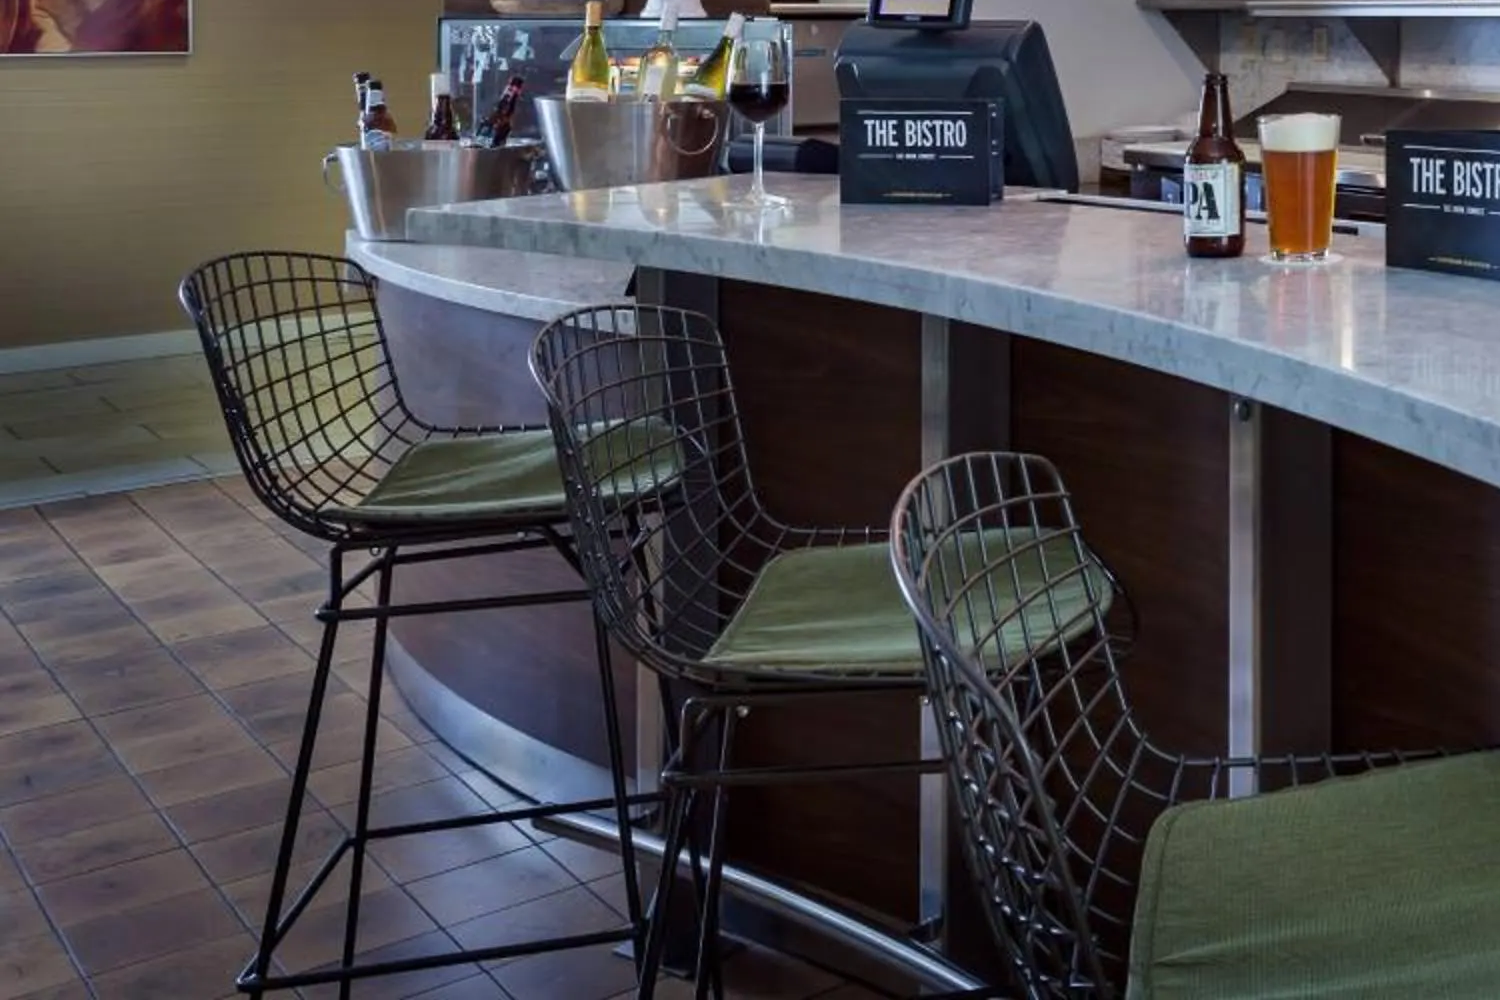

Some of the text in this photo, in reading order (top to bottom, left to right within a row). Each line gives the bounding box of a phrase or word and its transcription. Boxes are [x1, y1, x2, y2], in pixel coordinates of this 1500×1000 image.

[863, 119, 967, 148] THE BISTRO
[1409, 157, 1447, 195] THE
